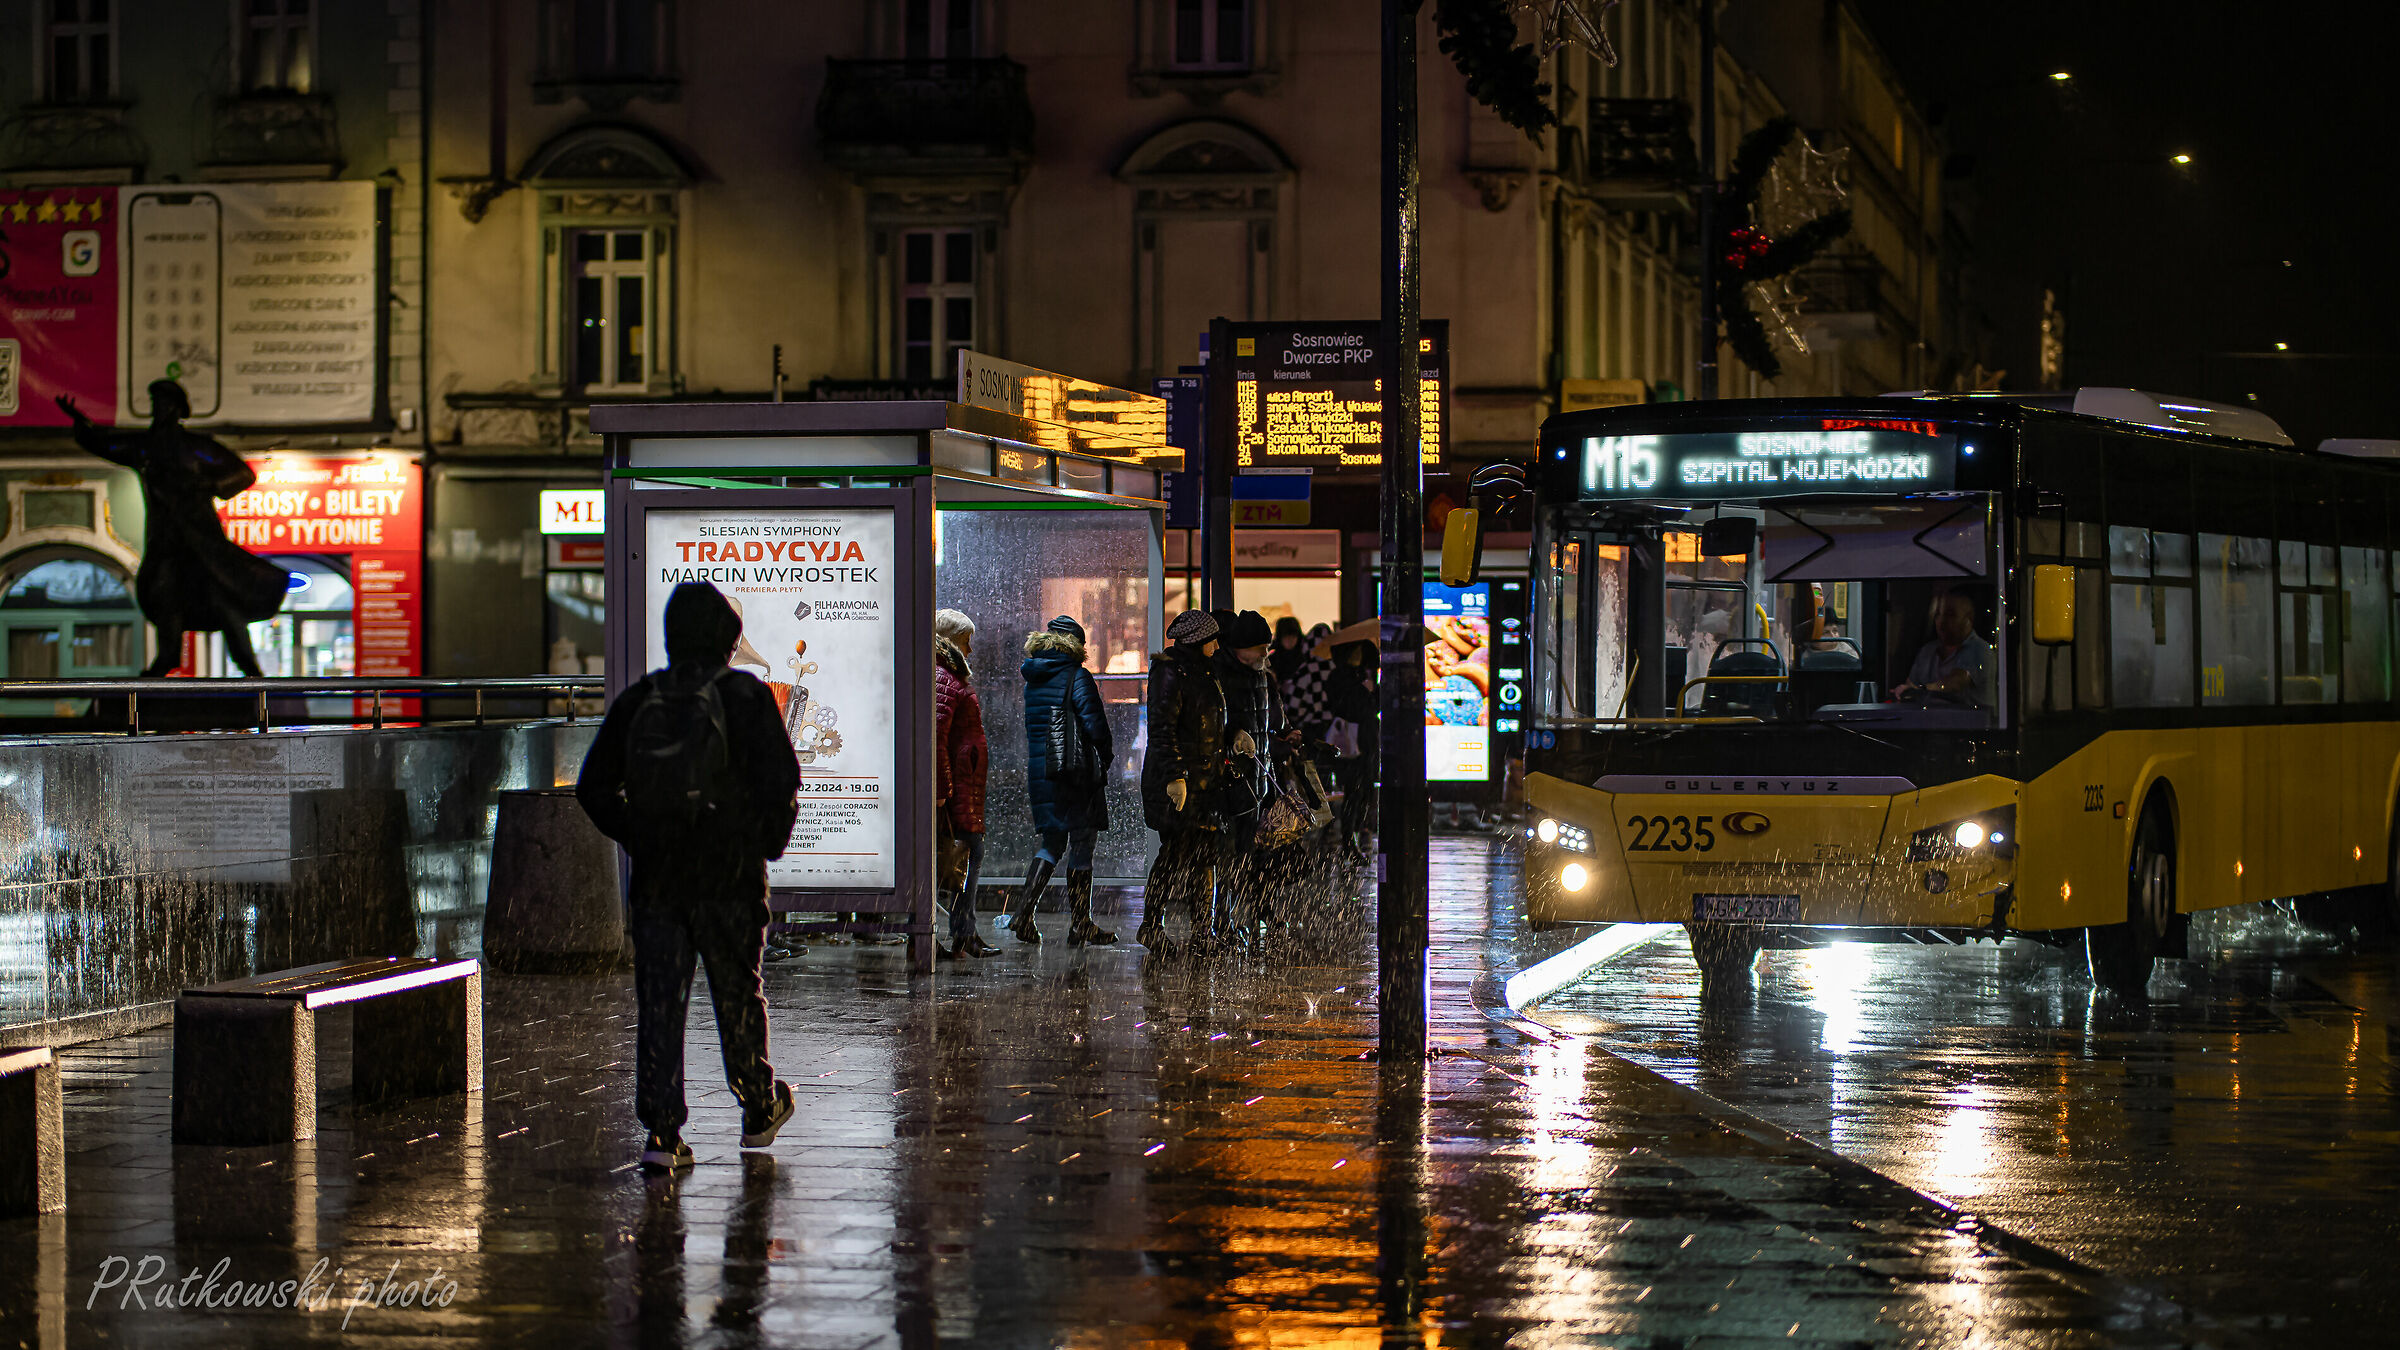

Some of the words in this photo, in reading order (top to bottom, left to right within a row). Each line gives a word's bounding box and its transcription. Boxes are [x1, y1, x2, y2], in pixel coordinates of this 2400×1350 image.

[1292, 331, 1364, 348] Sosnowiec
[1283, 350, 1341, 365] Dworzec
[1343, 349, 1374, 364] PKP
[1237, 369, 1255, 379] linia
[1273, 369, 1312, 380] kierunek
[1181, 379, 1197, 388] T-26
[1237, 402, 1257, 413] 188
[1307, 401, 1346, 413] Szpital
[1346, 400, 1383, 413] Wojewó
[1237, 412, 1257, 424] 150
[1266, 432, 1320, 445] Sosnowiec
[1354, 431, 1383, 444] Miast
[1266, 444, 1299, 456] Bytom
[1299, 443, 1344, 455] Dworzec
[1585, 435, 1657, 490] M15
[1740, 433, 1870, 456] SOSNOWIEC
[1682, 459, 1778, 484] SZPITAL
[1783, 456, 1929, 482] WOJEWÓDZKI
[213, 489, 310, 517] IEROSY
[325, 489, 405, 516] BILETY
[1242, 504, 1283, 521] ZTM
[287, 518, 384, 545] TYTONIE
[699, 526, 760, 537] SILESIAN
[763, 526, 842, 537] SYMPHONY
[675, 540, 866, 562] TRADYCYJA
[1236, 542, 1299, 560] wędliny
[661, 567, 747, 583] MARCIN
[753, 567, 879, 583] WYROSTEK
[814, 600, 880, 610] FILHARMONIA
[814, 608, 851, 622] ŚLĄSKA
[2203, 664, 2225, 697] ZTM
[799, 783, 843, 792] 02.2024
[850, 783, 880, 793] 19.00
[798, 802, 819, 811] SKIEJ,
[819, 802, 842, 811] Zespół
[815, 810, 858, 818] JAJKIEWICZ,
[796, 818, 824, 826] RYNICZ,
[1627, 814, 1715, 853] 2235
